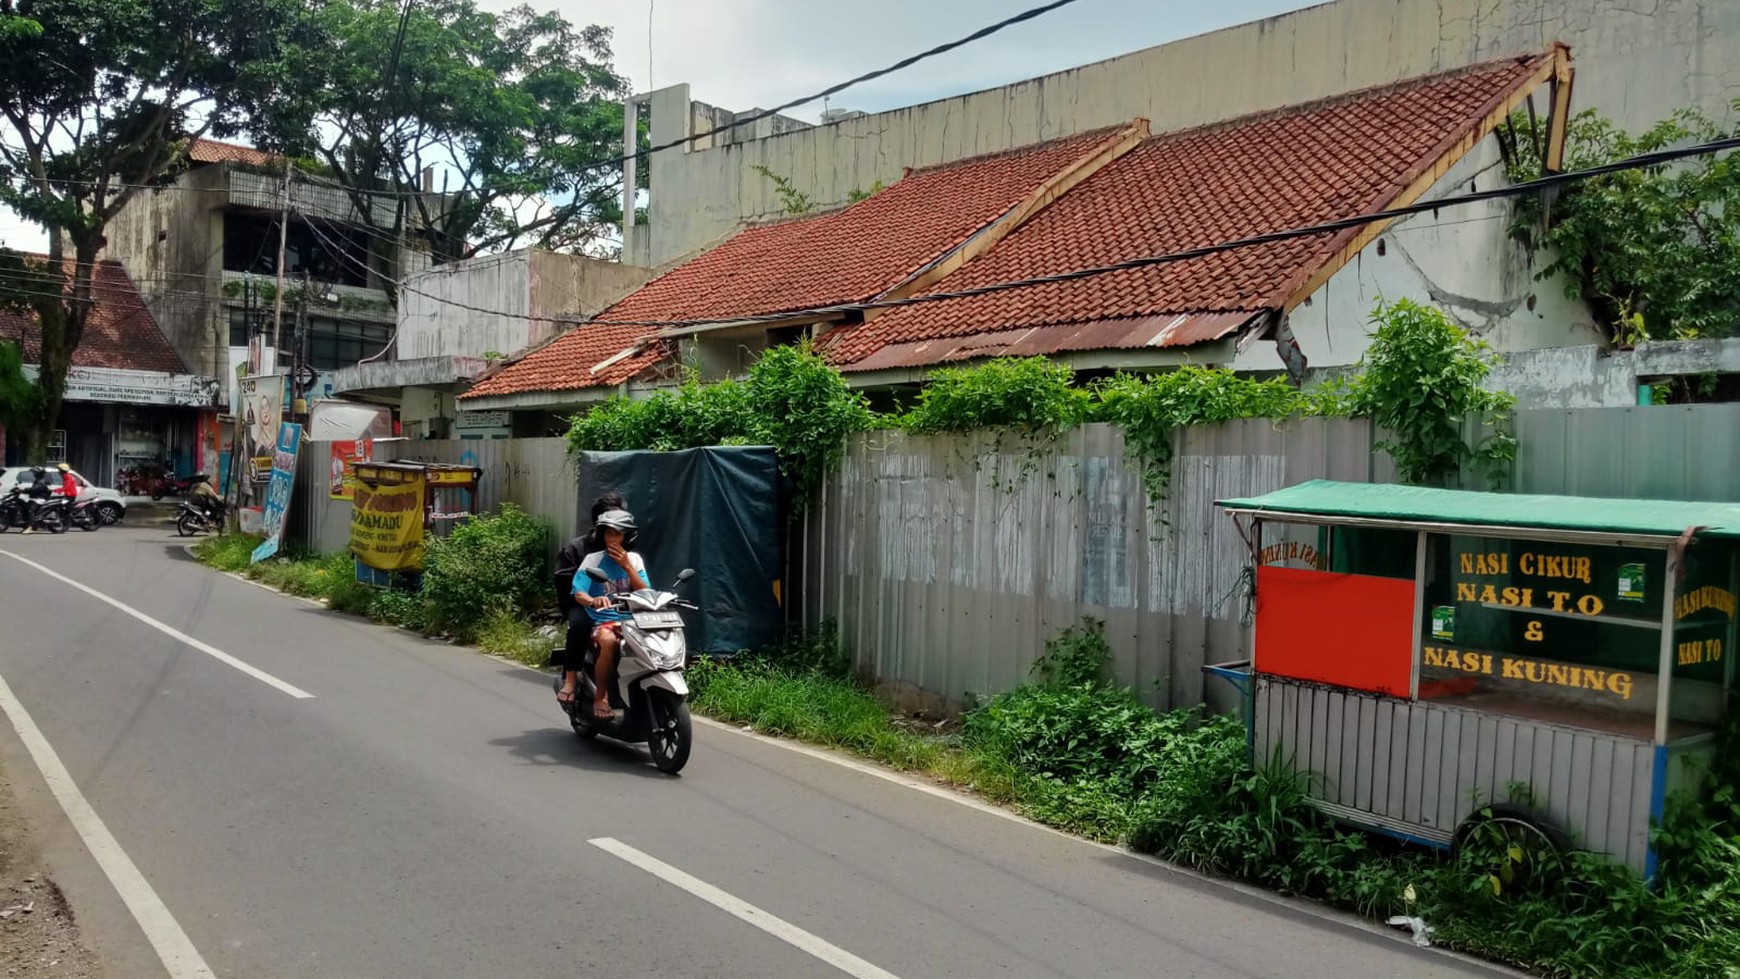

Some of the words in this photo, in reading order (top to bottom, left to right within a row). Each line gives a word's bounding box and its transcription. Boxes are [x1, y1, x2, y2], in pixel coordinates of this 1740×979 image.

[242, 380, 256, 394] 240
[1461, 553, 1507, 575] NASI
[1519, 552, 1591, 583] CIKUR
[1457, 583, 1533, 608] NASI
[1547, 591, 1604, 615] T.O
[1524, 621, 1544, 641] &
[1679, 641, 1702, 665] NASI
[1706, 639, 1720, 661] TO
[1424, 647, 1492, 674] NASI
[1502, 658, 1633, 699] KUNING
